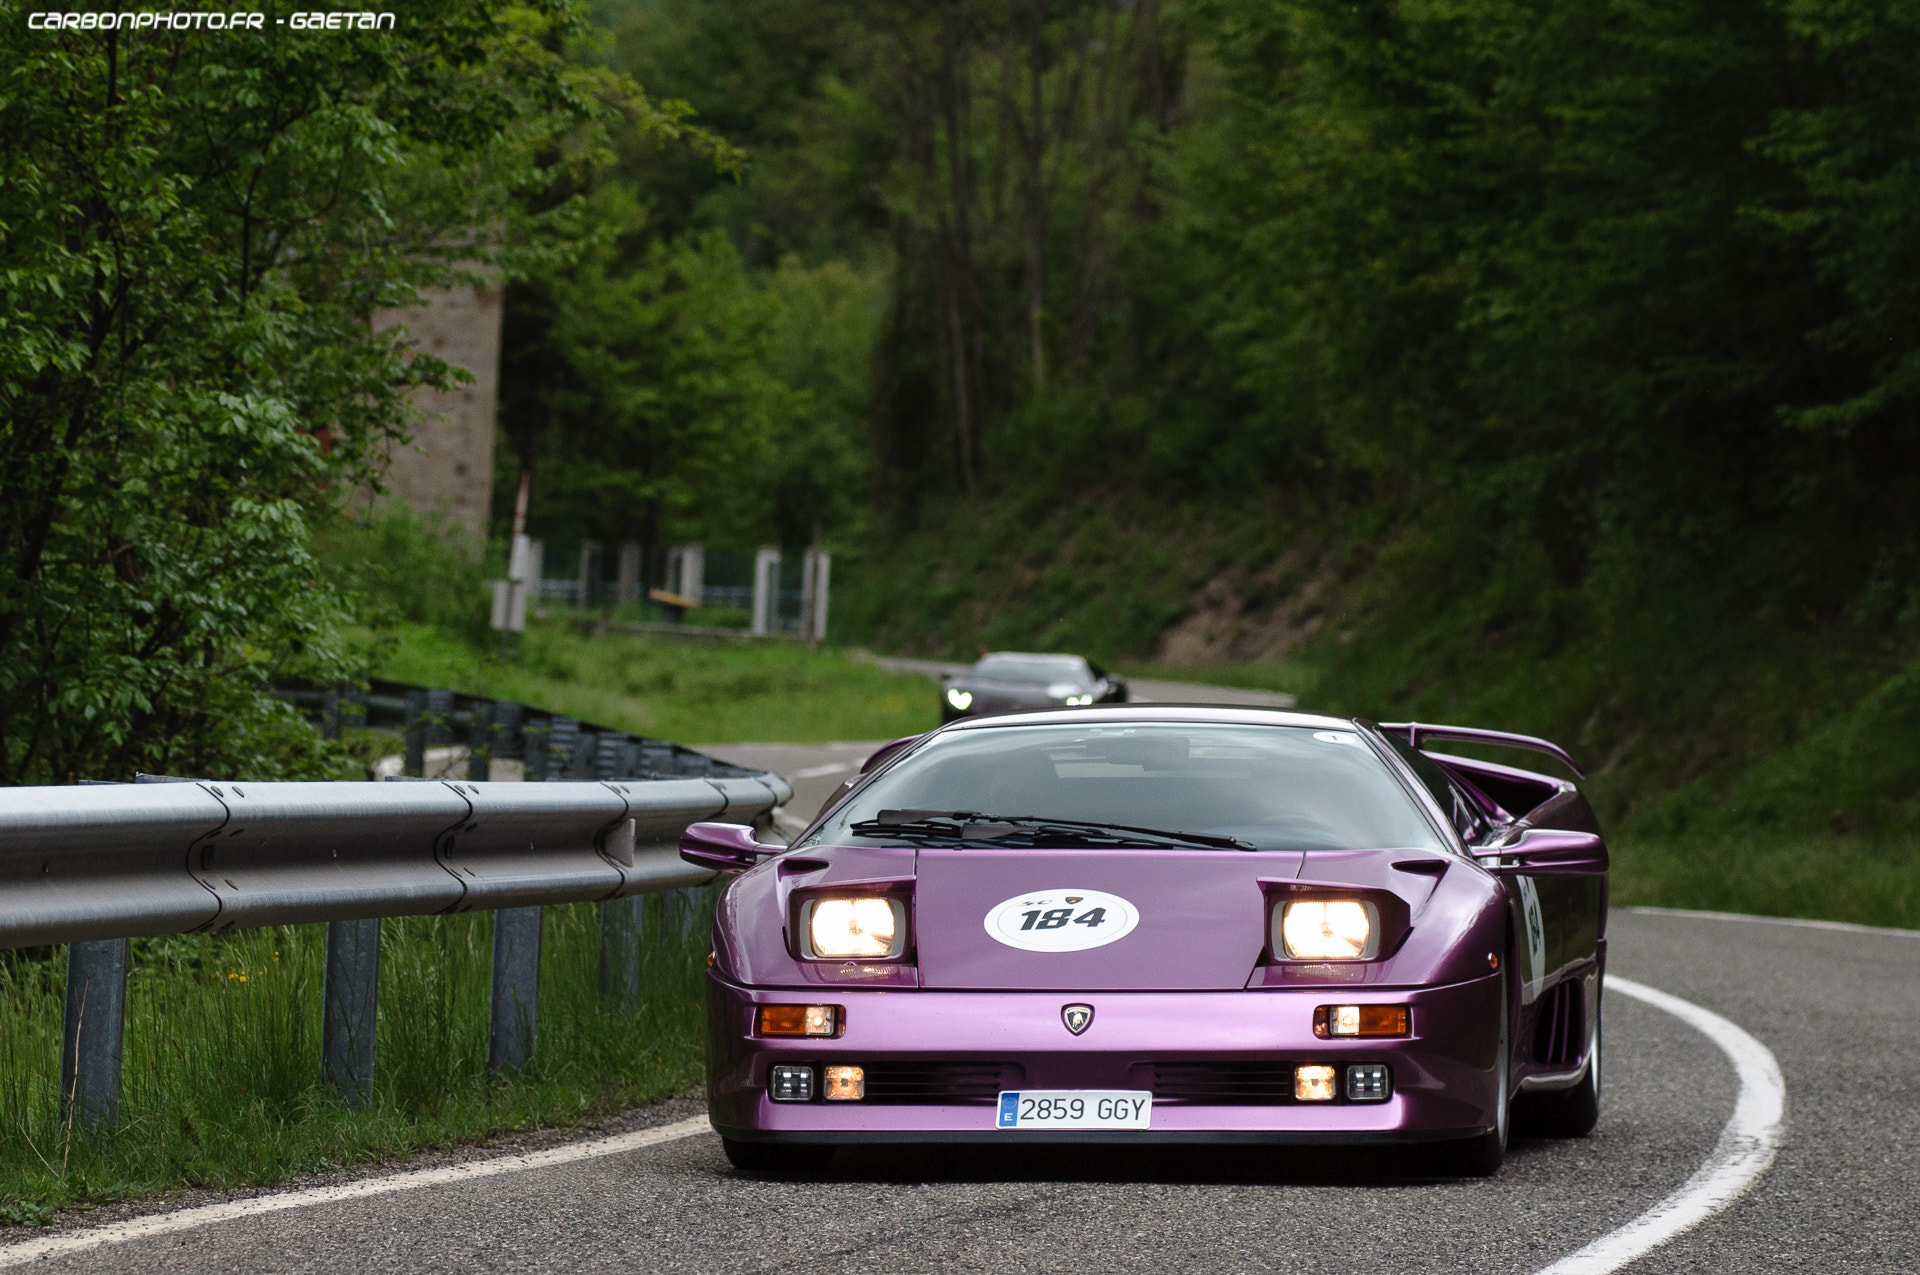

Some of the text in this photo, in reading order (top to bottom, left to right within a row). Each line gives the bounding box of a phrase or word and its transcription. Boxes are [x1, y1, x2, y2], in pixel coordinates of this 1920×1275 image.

[1020, 907, 1107, 931] 184
[1004, 1112, 1013, 1122] E
[1020, 1098, 1146, 1121] 2859 GGY
